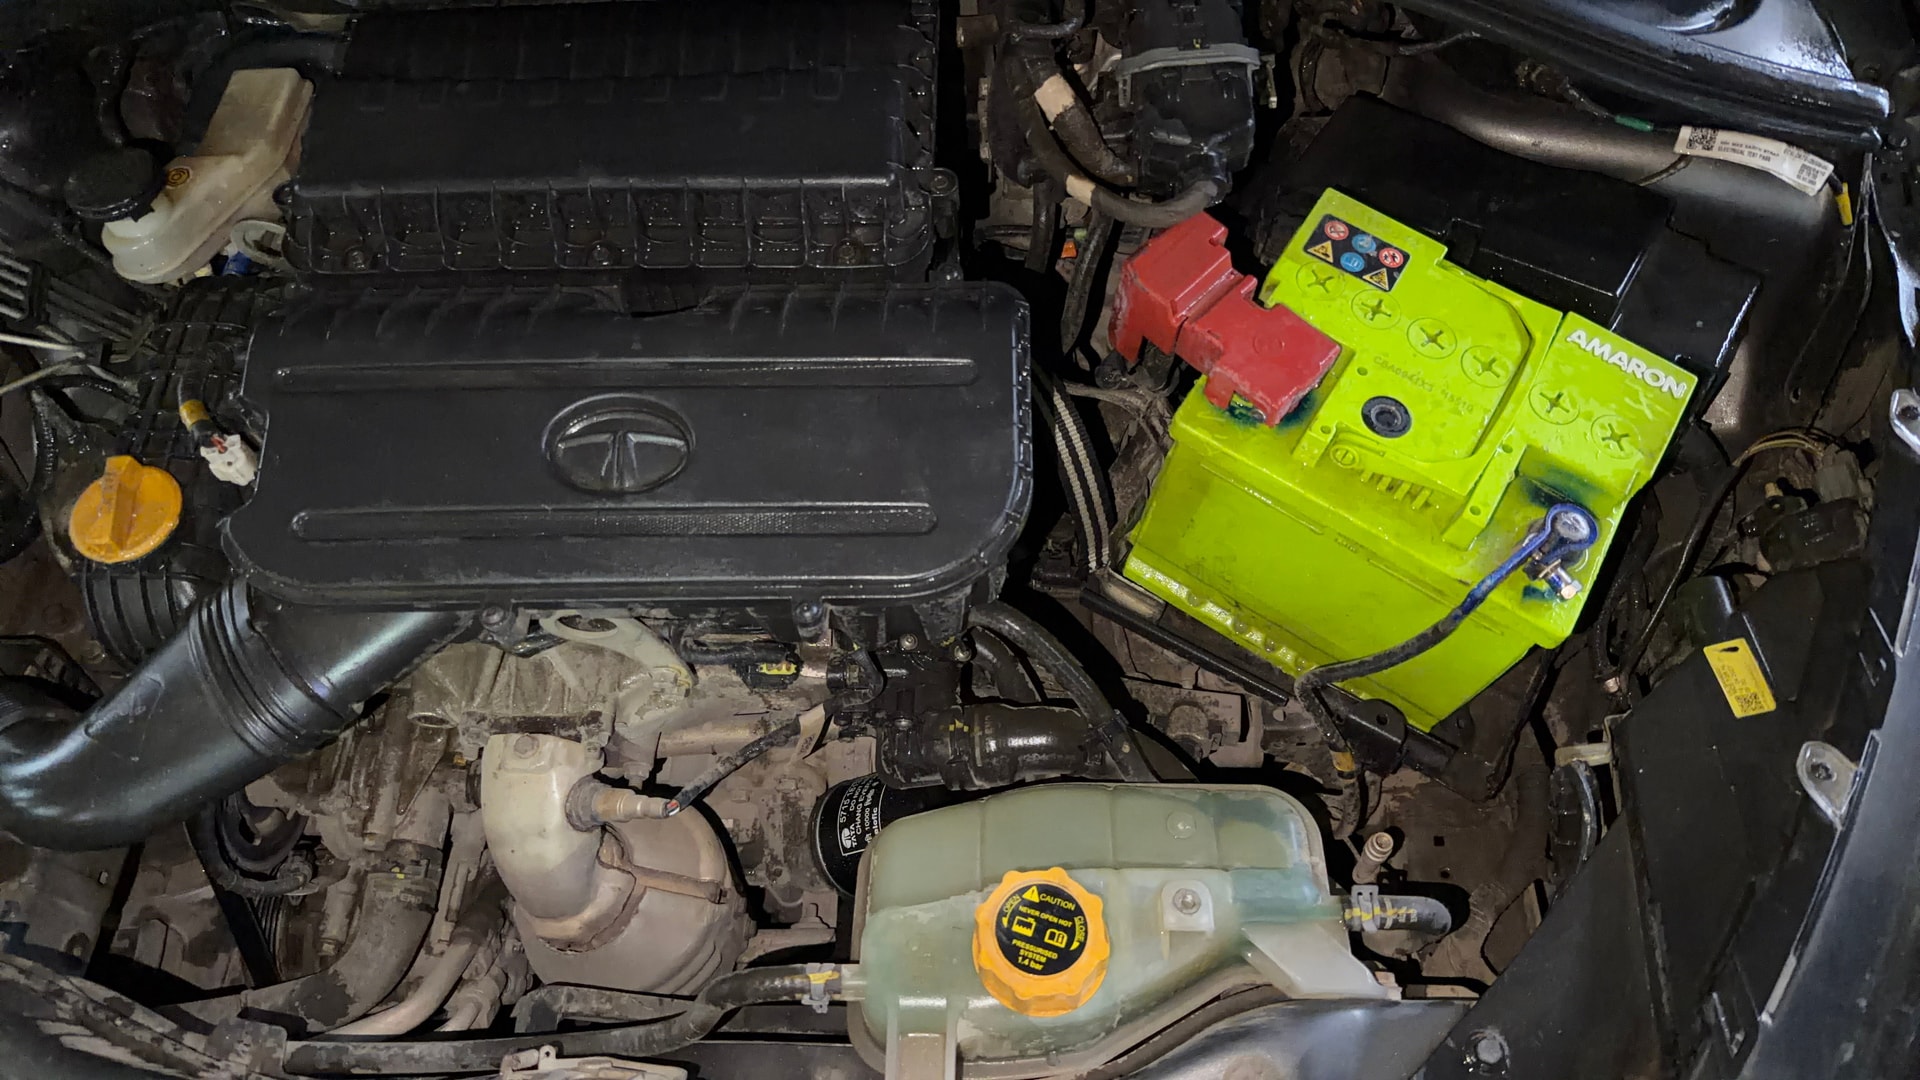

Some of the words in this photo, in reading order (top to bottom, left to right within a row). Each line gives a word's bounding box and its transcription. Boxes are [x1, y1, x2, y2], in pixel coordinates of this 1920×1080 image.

[1566, 329, 1687, 399] AMARON
[1003, 894, 1021, 912] OPEN
[1040, 893, 1075, 910] CAUTION
[1019, 905, 1040, 917] NEVER
[1040, 912, 1058, 924] OPEN
[1058, 918, 1073, 928] HOT
[1078, 915, 1086, 942] CLOSE
[1012, 939, 1058, 960] PRESSURISED
[1019, 949, 1047, 963] SYSTEM
[1018, 957, 1029, 966] 1.4
[1029, 960, 1044, 971] bar
